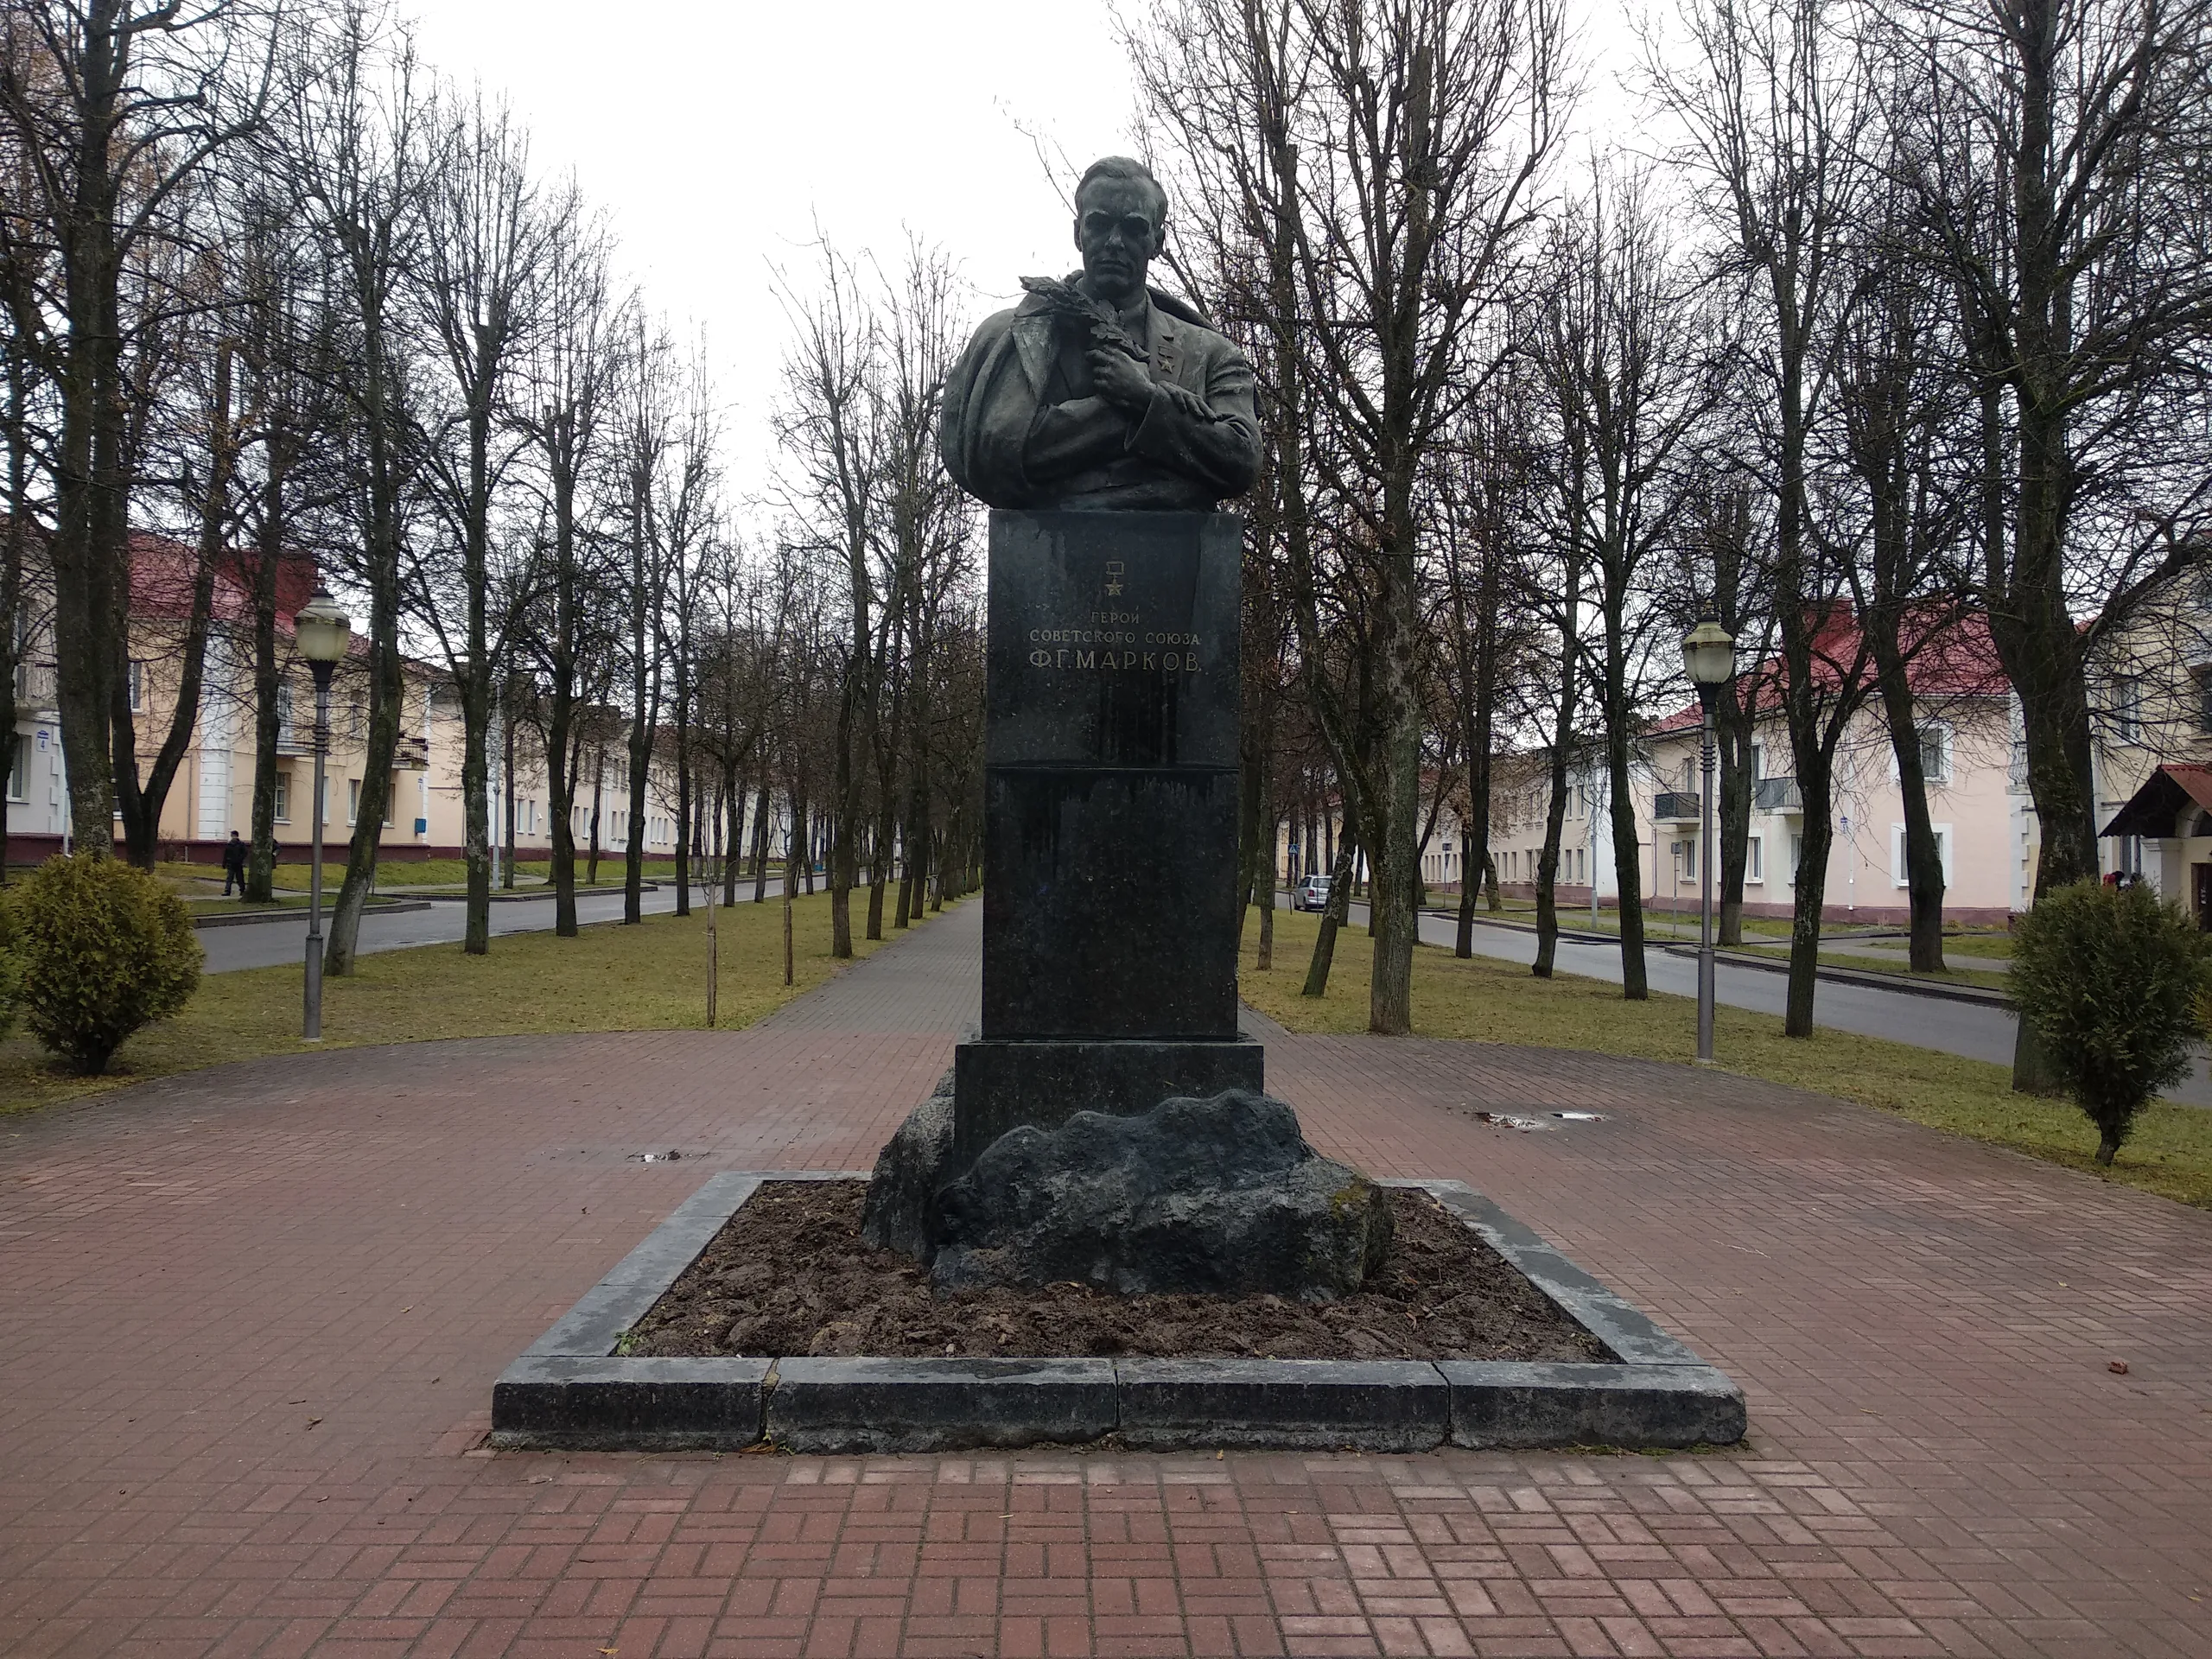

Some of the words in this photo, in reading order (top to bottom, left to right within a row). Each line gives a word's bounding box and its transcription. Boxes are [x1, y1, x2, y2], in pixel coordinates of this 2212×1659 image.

[1091, 607, 1140, 624] ГЕРОЙ
[1029, 629, 1136, 644] СОВЕТСКОГО
[1145, 632, 1201, 645] СОЮЗА
